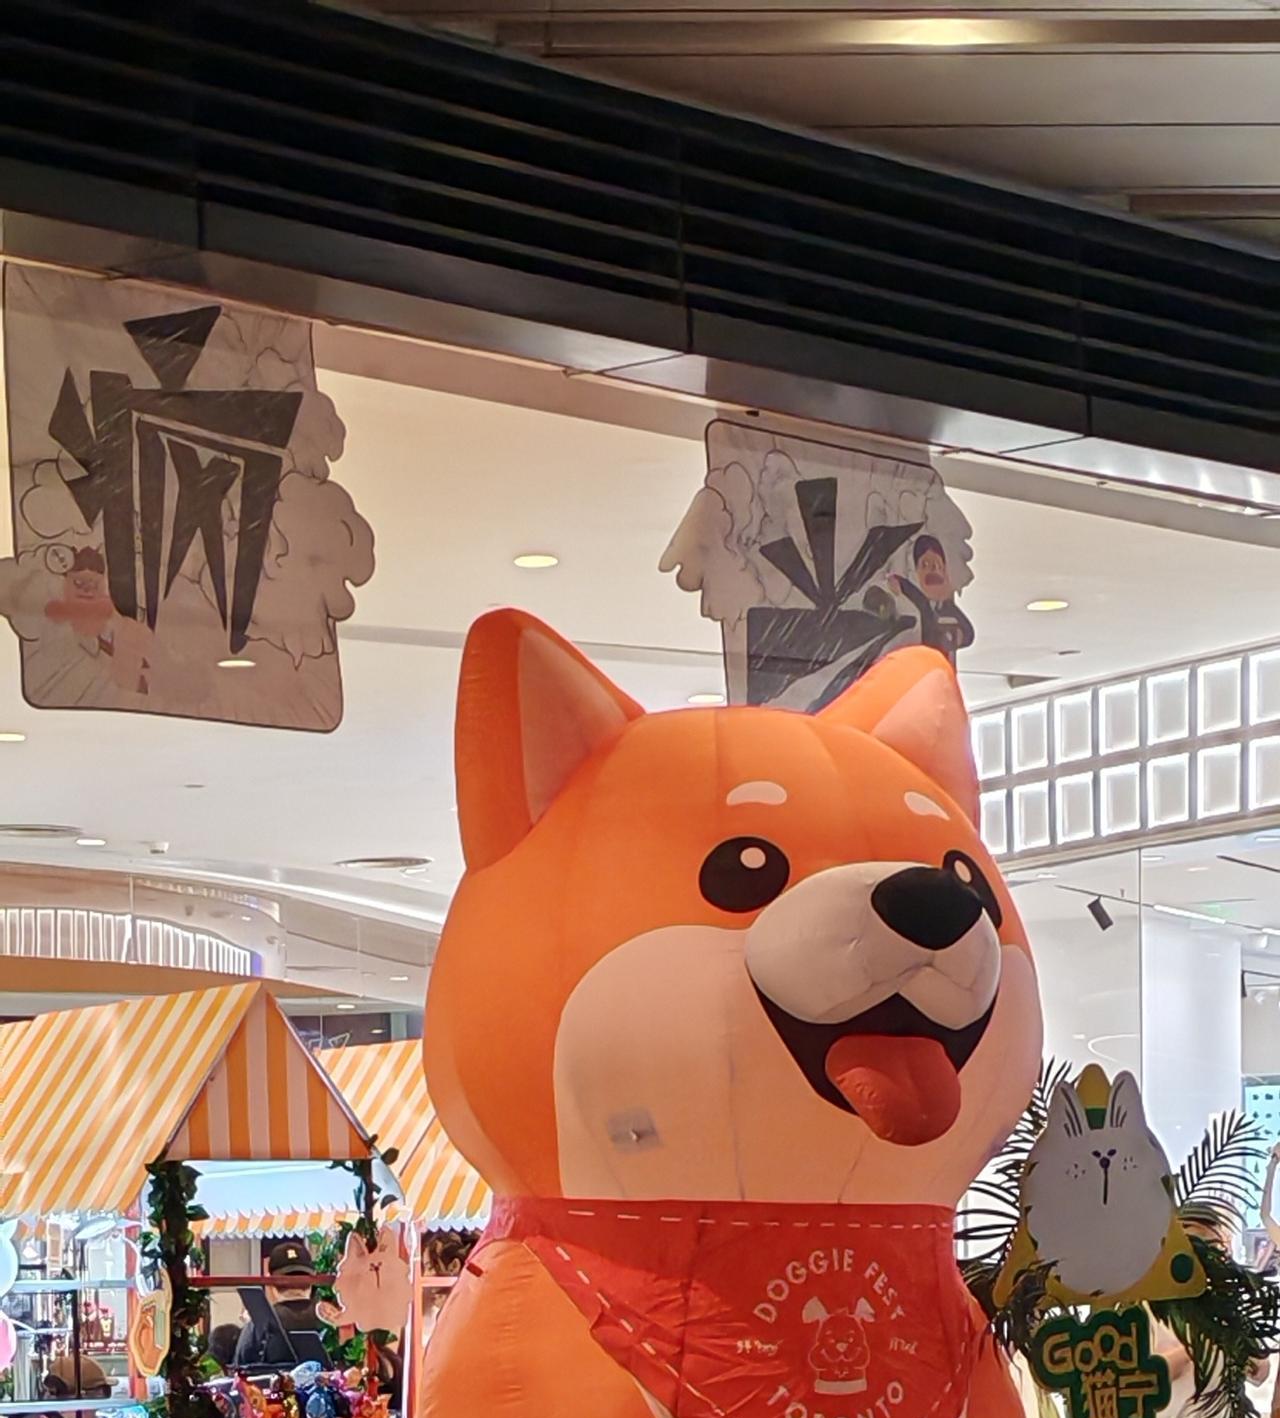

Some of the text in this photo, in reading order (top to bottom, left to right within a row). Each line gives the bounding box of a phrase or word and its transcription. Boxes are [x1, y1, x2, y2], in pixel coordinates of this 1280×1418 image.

[752, 1248, 905, 1324] DOGGIE FEST
[1042, 1322, 1139, 1374] Good
